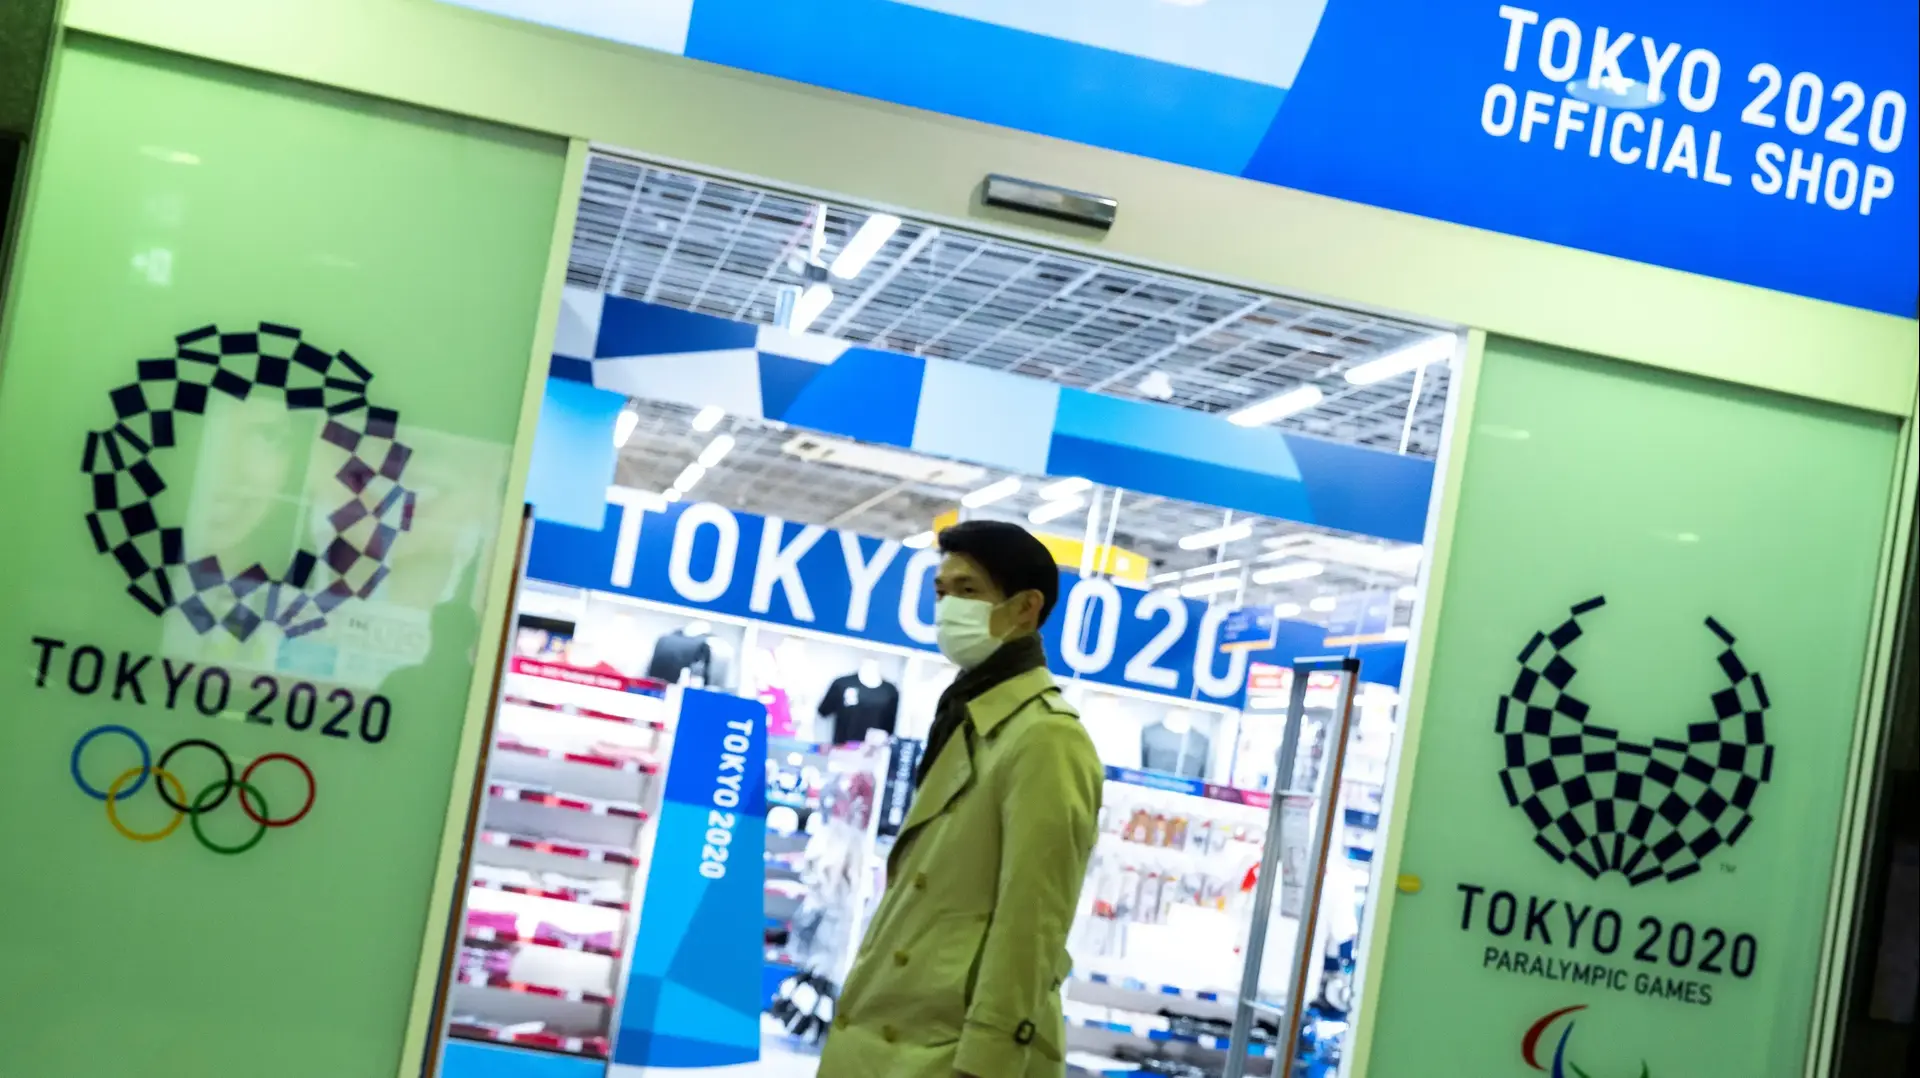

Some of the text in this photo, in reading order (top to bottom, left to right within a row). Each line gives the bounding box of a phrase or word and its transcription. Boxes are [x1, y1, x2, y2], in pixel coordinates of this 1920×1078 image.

[1498, 4, 1908, 154] TOKYO 2020
[1480, 83, 1896, 216] OFFICIAL SHOP
[31, 635, 393, 744] TOKYO 2020
[1060, 578, 1250, 699] 020
[699, 718, 754, 880] TOKYO 2020
[1457, 883, 1758, 979] TOKYO 2020
[1482, 946, 1714, 1006] PARALYMPIC GAMES
